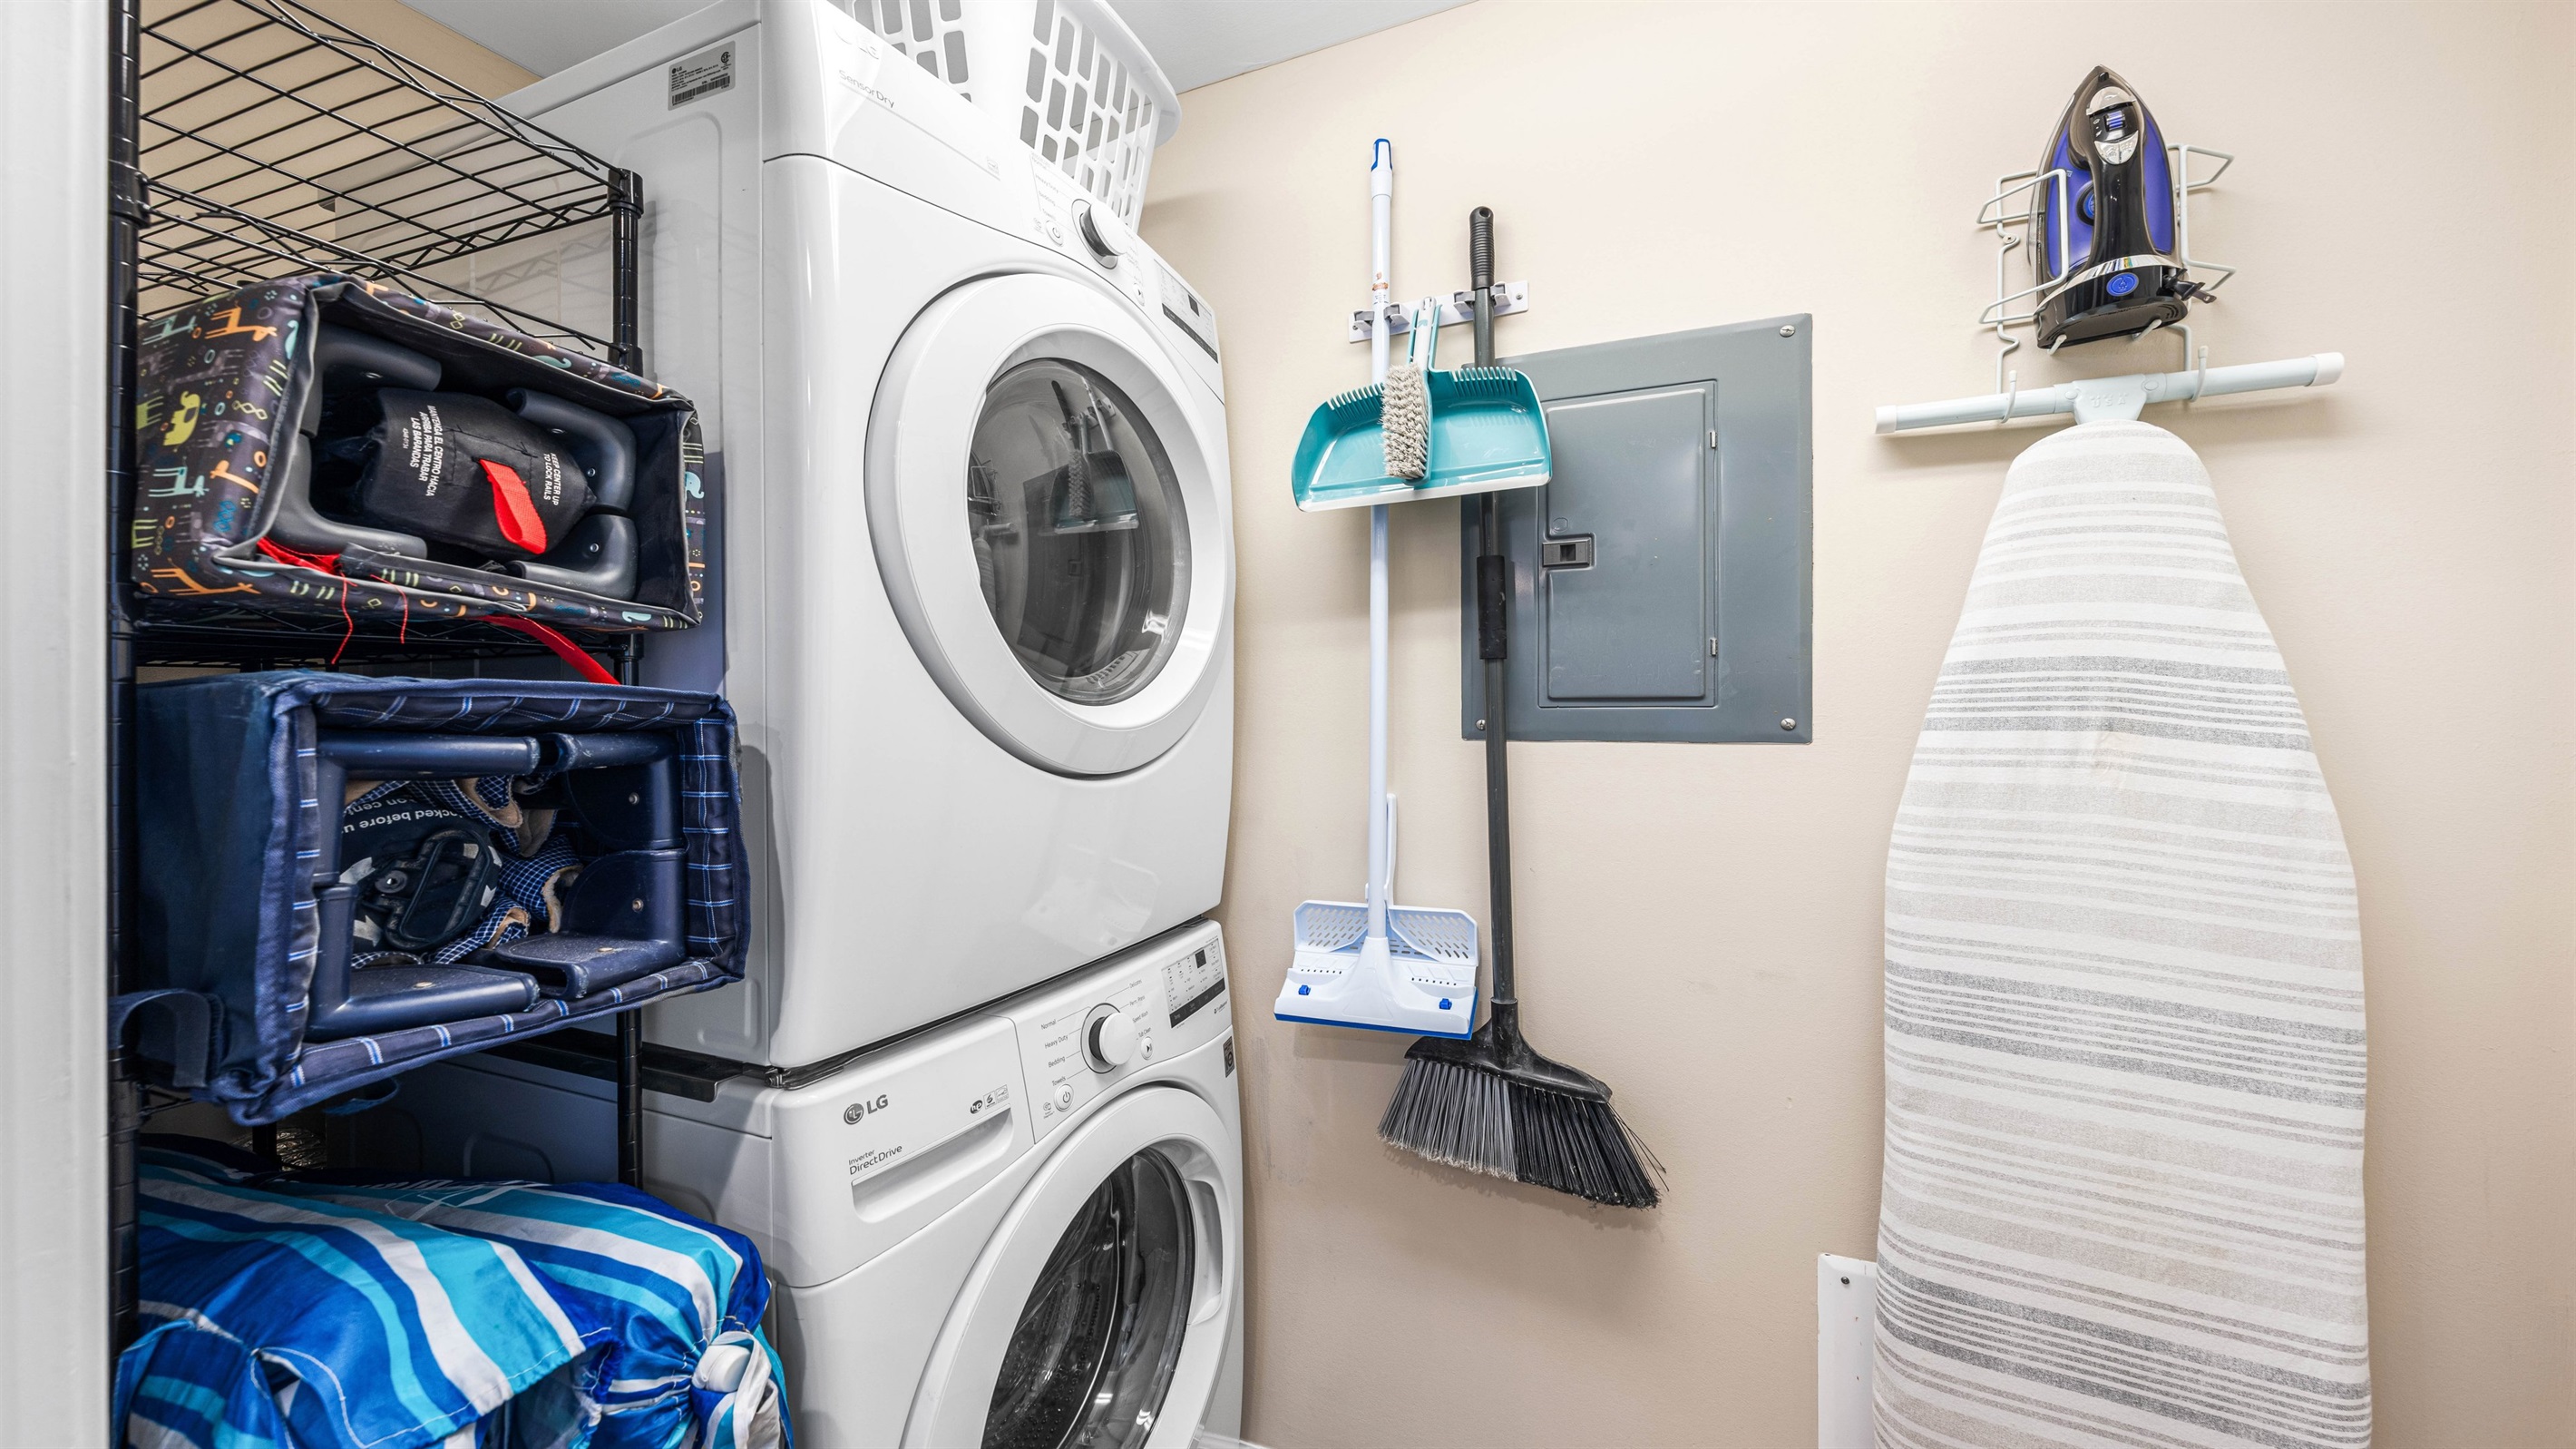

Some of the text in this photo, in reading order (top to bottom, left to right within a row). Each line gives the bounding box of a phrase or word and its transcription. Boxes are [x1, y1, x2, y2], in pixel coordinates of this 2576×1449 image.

[409, 416, 422, 468] LAS BARANDAS
[418, 411, 433, 482] ARRIBA PARA TRABAR
[424, 405, 444, 497] MANTENGA EL CENTRO HACIA
[542, 453, 553, 501] TO LOCK RAILS
[550, 452, 561, 506] KEEP CENTER UP
[340, 823, 356, 834] u
[358, 810, 412, 830] before
[1040, 1019, 1057, 1030] Normal
[1044, 1034, 1068, 1050] Heavy Duty
[1048, 1055, 1066, 1068] Bedding
[1051, 1076, 1067, 1087] Towels
[866, 1093, 889, 1114] LG
[848, 1149, 875, 1166] Inverter
